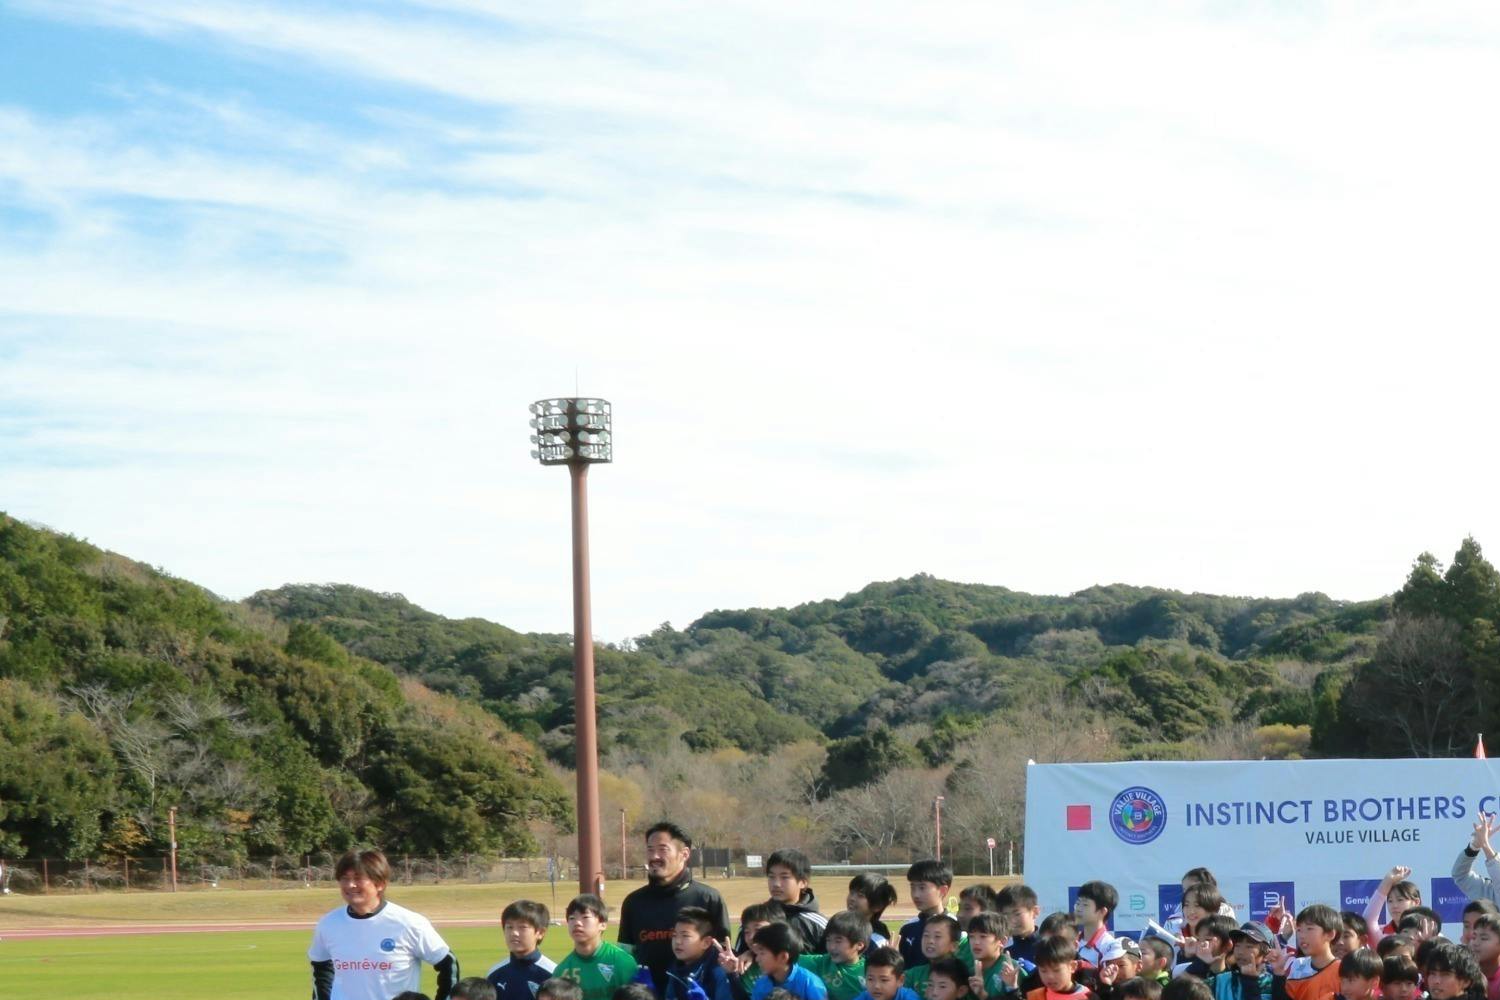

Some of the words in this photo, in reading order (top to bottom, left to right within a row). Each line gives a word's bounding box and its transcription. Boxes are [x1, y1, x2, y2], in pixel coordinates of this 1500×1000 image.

[1114, 792, 1134, 815] VALUE
[1135, 791, 1162, 816] VILLAGE
[1186, 800, 1312, 826] INSTINCT
[1324, 795, 1466, 823] BROTHERS
[1305, 830, 1353, 844] VALUE
[1358, 828, 1420, 843] VILLAGE
